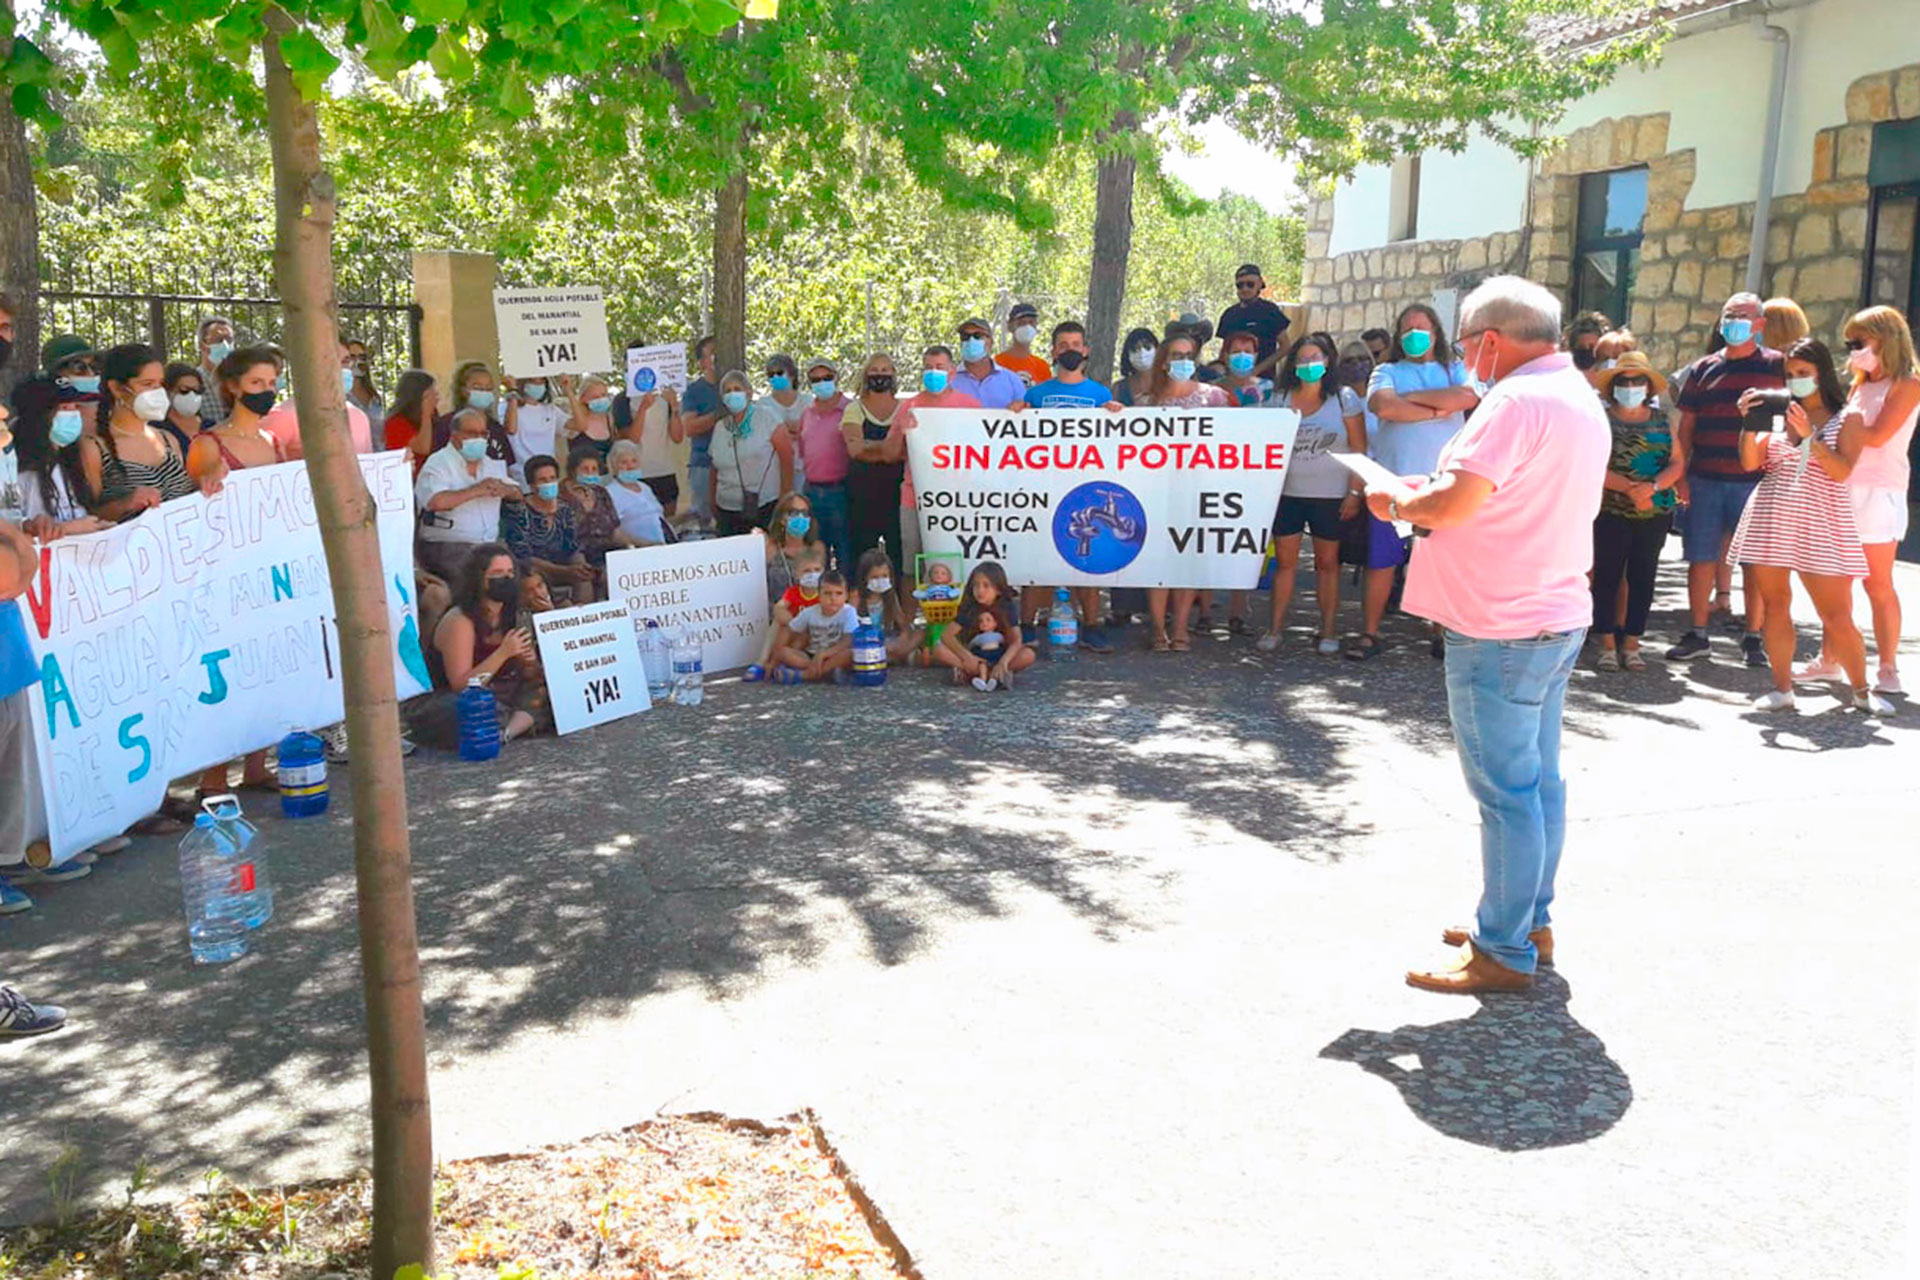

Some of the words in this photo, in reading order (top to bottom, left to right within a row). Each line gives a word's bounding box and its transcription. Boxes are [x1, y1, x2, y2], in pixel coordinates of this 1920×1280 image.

[498, 296, 542, 305] QUEREMOS
[544, 295, 564, 303] AGUA
[566, 293, 599, 302] POTABLE
[521, 312, 536, 320] DEL
[538, 310, 582, 319] MANANTIAL
[530, 328, 539, 336] DE
[559, 326, 578, 335] JUAN
[537, 343, 577, 367] ¡YA!
[982, 416, 1214, 438] VALDESIMONTE
[932, 444, 990, 470] SIN
[998, 444, 1105, 470] AGUA
[1117, 443, 1285, 470] POTABLE
[1199, 491, 1244, 519] ES
[927, 510, 1038, 532] POLÍTICA
[27, 455, 405, 639] VALDESIMOE
[956, 534, 1007, 559] YA!
[618, 564, 704, 591] QUEREMOS
[707, 559, 750, 577] AGUA
[539, 616, 580, 633] QUEREMOS
[581, 613, 599, 625] AGUA
[600, 607, 628, 621] POTABLE
[656, 602, 747, 628] MANANTIAL
[563, 640, 578, 651] DEL
[580, 632, 617, 648] MANANTIAL
[573, 660, 584, 672] DE
[585, 657, 600, 670] SAN
[600, 654, 617, 667] JUAN
[41, 616, 170, 740] AGUA
[584, 675, 621, 713] ¡YA!
